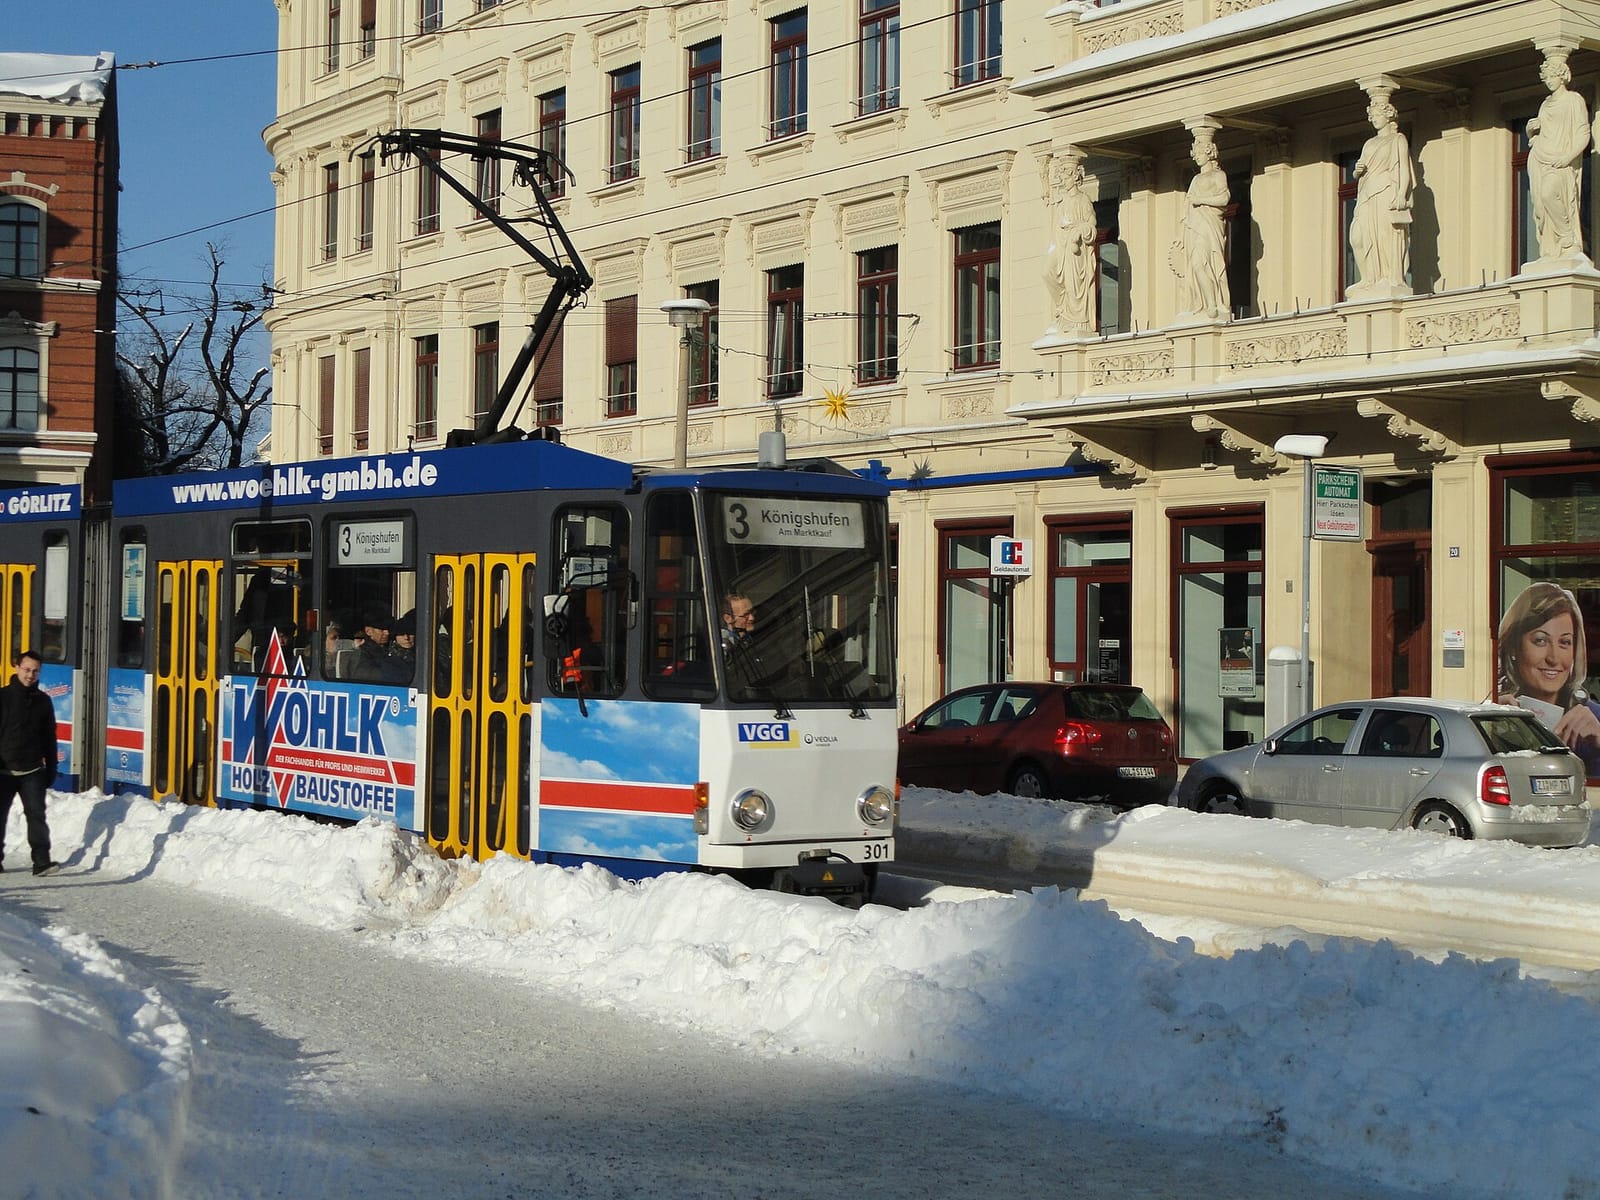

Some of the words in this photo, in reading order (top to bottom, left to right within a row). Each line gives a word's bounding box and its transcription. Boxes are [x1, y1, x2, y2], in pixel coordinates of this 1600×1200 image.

[171, 455, 438, 504] www.woehlk-gmbh.de
[1318, 473, 1357, 486] PARKSCHEIN-
[1324, 486, 1352, 498] AUTOMAT
[8, 490, 72, 515] GÖRLITZ
[1330, 500, 1358, 509] Parkschein
[728, 502, 750, 540] 3
[761, 509, 850, 528] Königshufen
[356, 530, 400, 547] Königshufen
[778, 527, 793, 536] Am
[794, 528, 833, 538] Marktkauf
[342, 526, 351, 558] 3
[231, 678, 389, 766] WÖHLK
[742, 724, 786, 741] VGG
[275, 754, 285, 763] DER
[285, 755, 315, 768] FACHHANDEL
[315, 758, 324, 769] FÜR
[324, 761, 341, 771] PROFIS
[341, 763, 353, 772] UND
[232, 765, 271, 793] HOLZ
[295, 774, 395, 813] BAUSTOFFE
[863, 843, 889, 860] 301
